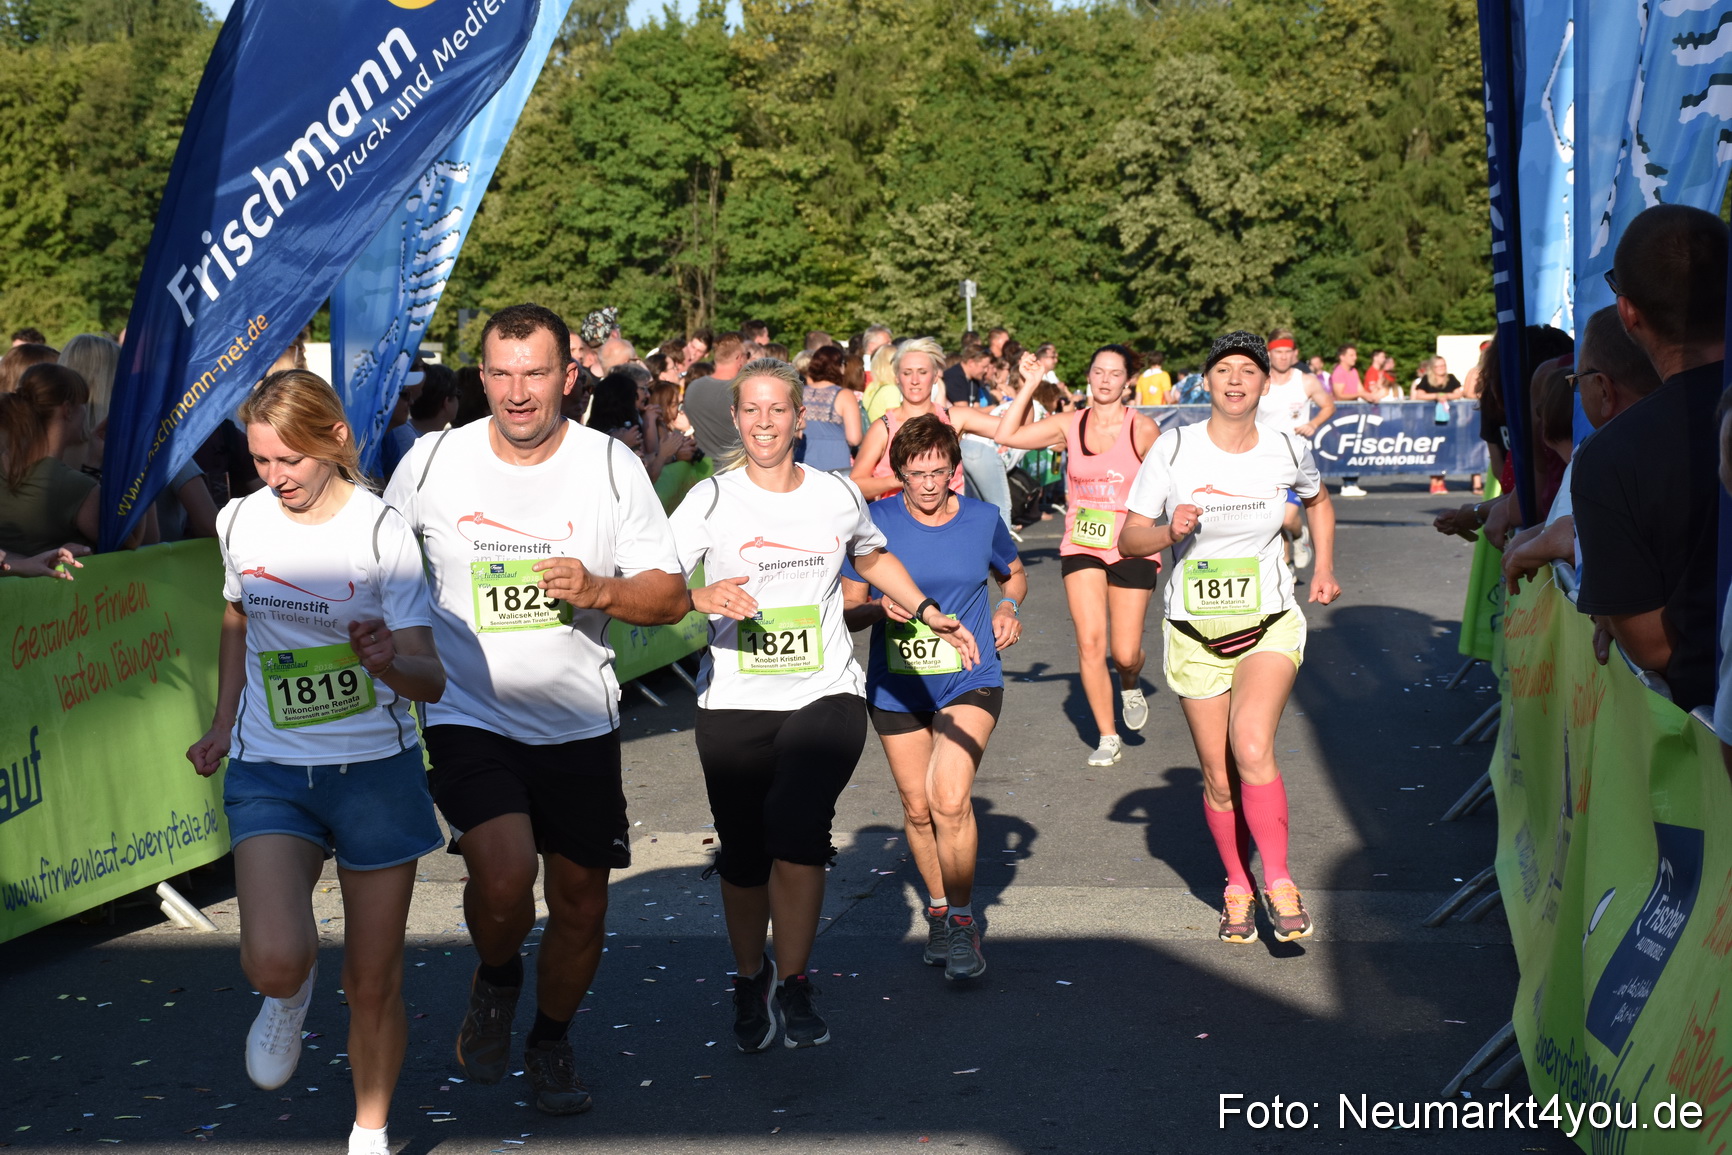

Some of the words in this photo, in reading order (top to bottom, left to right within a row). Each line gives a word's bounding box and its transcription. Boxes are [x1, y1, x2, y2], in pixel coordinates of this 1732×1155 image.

[326, 117, 391, 191] Druck
[390, 63, 434, 120] und
[432, 0, 505, 72] Medie
[166, 27, 418, 327] Frischmann
[1337, 432, 1446, 454] Fischer
[1347, 454, 1436, 466] AUTOMOBILE
[1205, 501, 1266, 513] Seniorenstift
[1204, 515, 1220, 523] am
[1222, 512, 1252, 521] Tiroler
[1077, 521, 1106, 537] 1450
[473, 540, 551, 554] Seniorenstift
[758, 556, 824, 571] Seniorenstift
[484, 571, 517, 579] firmenlauf
[758, 574, 774, 584] am
[775, 570, 810, 580] Tiroler
[812, 567, 829, 579] Hof
[1194, 578, 1250, 599] 1817
[248, 593, 330, 615] Seniorenstift
[12, 592, 90, 671] Gesunde
[94, 582, 150, 632] Firmen
[249, 610, 266, 620] am
[268, 609, 311, 624] Tiroler
[313, 616, 338, 629] Hof
[747, 629, 808, 656] 1821
[898, 637, 941, 659] 667
[54, 651, 113, 713] laufen
[109, 611, 181, 684] länger!
[273, 660, 308, 670] firmenlauf
[277, 669, 358, 706] 1819
[282, 703, 330, 715] Vilkonciene
[331, 695, 360, 707] Renata
[284, 712, 320, 721] Seniorenstift
[331, 706, 349, 714] Tiroler
[2, 799, 219, 911] www.firmenlauf-oberpfalz.de
[1645, 893, 1686, 939] Fischer
